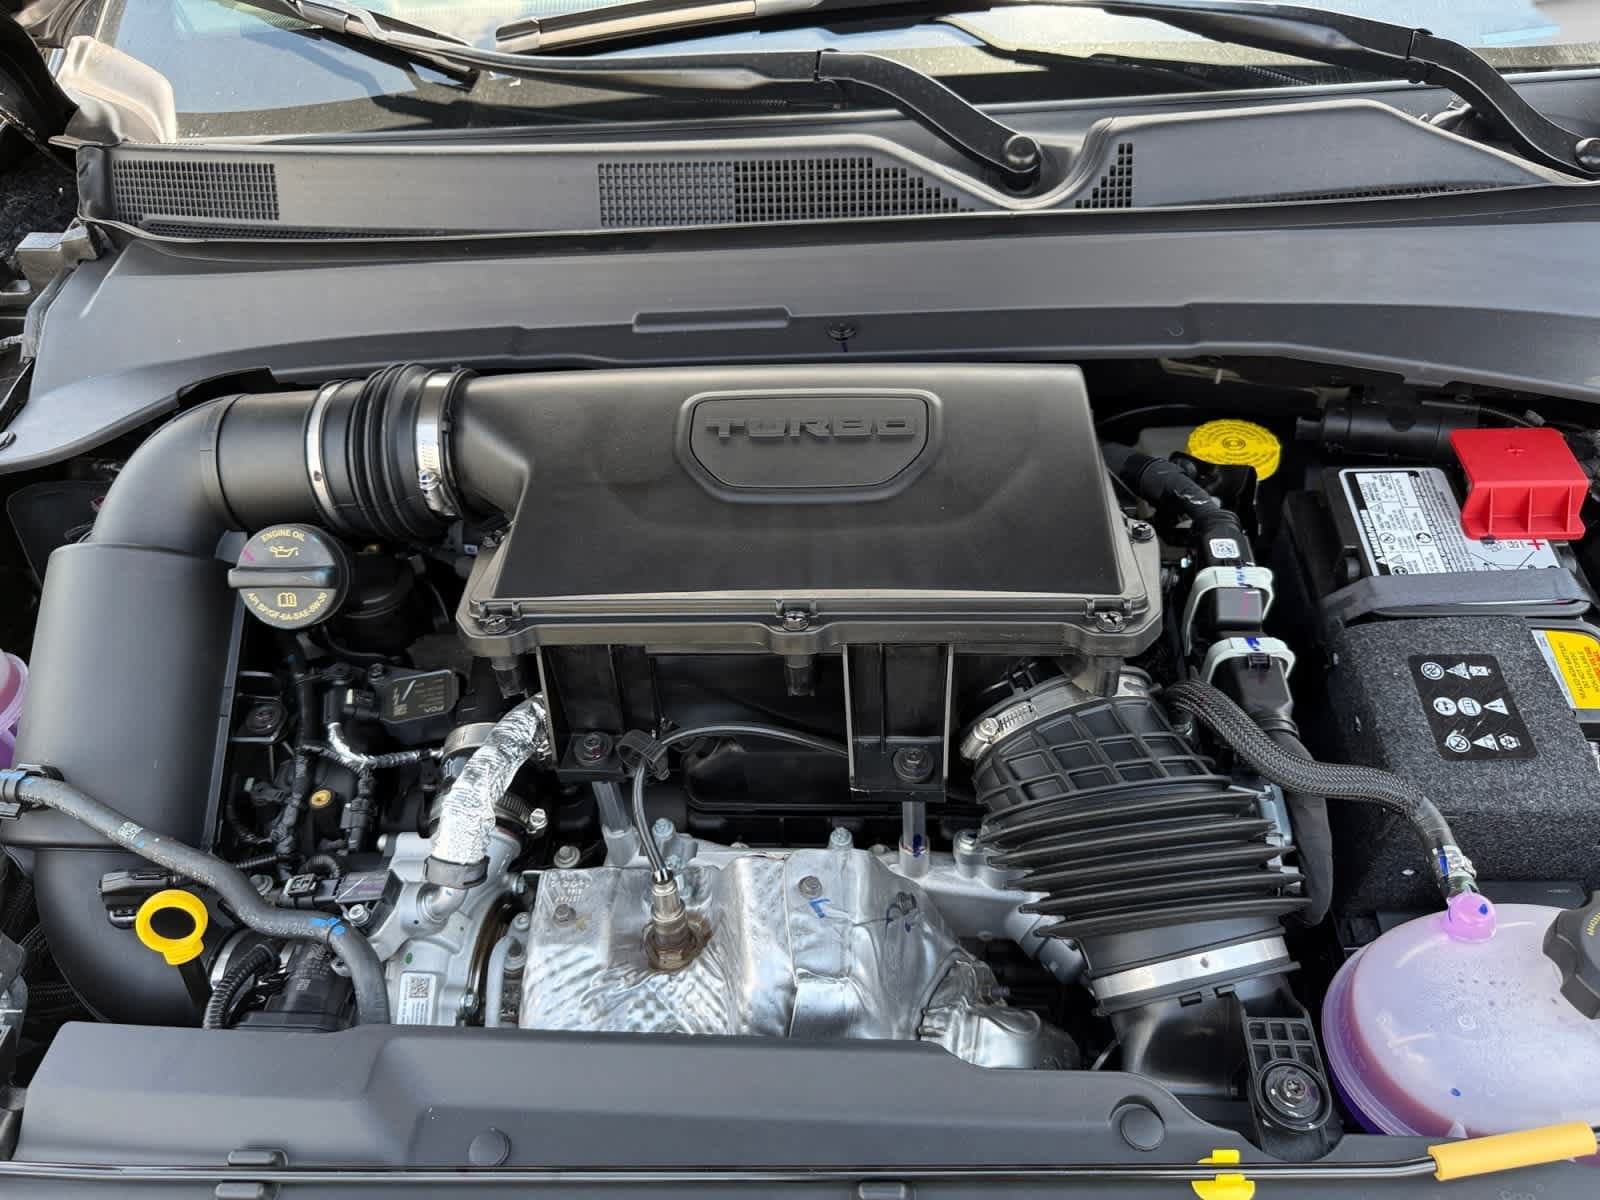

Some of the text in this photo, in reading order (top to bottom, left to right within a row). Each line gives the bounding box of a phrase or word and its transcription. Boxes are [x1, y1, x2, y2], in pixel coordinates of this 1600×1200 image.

[706, 416, 915, 442] TURBO
[260, 528, 305, 542] ENGINE OIL
